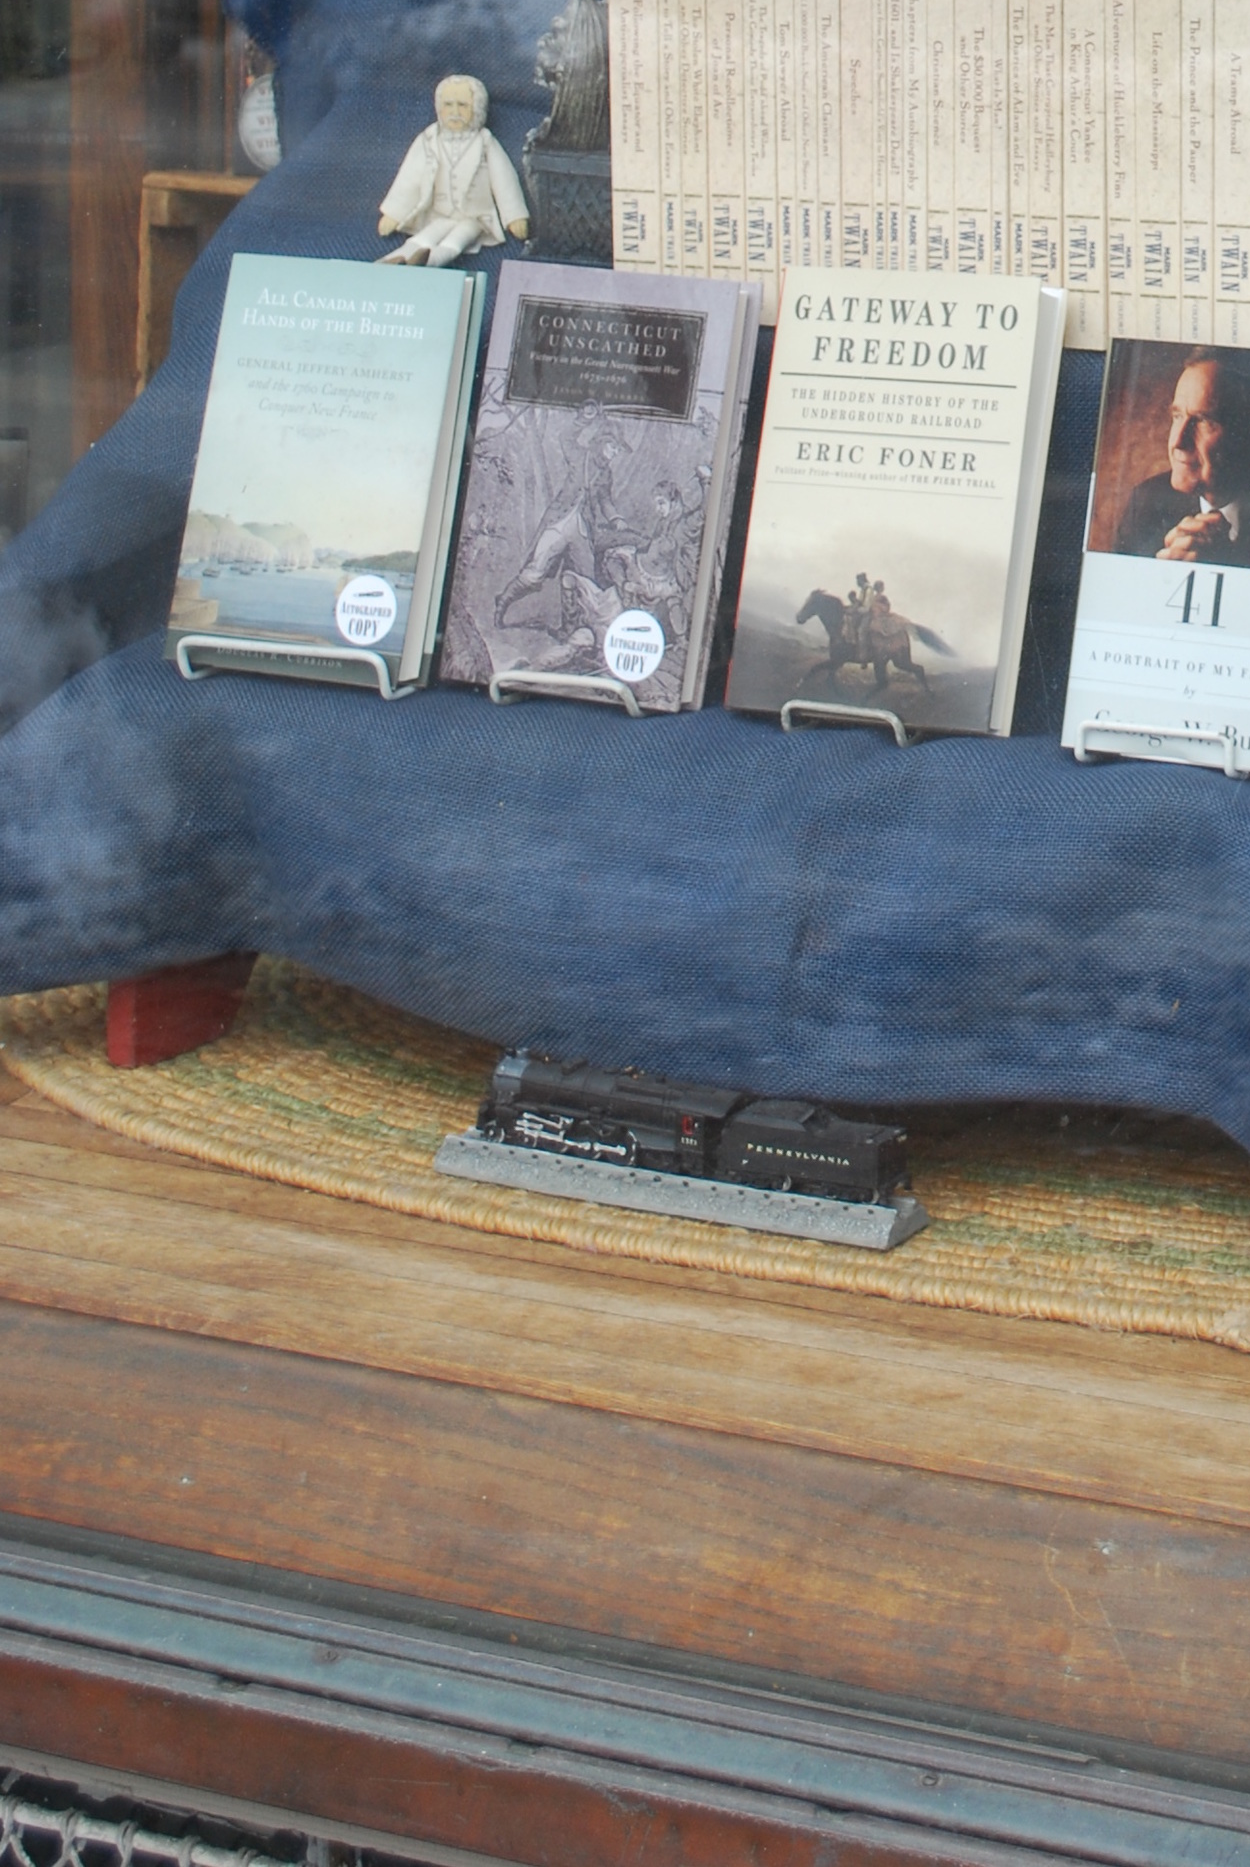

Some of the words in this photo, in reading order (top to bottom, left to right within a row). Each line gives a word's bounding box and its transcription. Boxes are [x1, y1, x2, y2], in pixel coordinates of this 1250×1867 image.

[848, 58, 861, 117] Speeches
[293, 289, 356, 313] CANADA
[361, 300, 378, 314] IN
[384, 301, 416, 317] THE
[794, 292, 958, 330] GATEWAY
[976, 303, 1020, 332] TO
[241, 306, 296, 329] HANDS
[300, 317, 320, 331] OF
[324, 319, 355, 334] THE
[359, 316, 425, 340] BRITISH
[538, 314, 682, 341] CONNECTICUT
[549, 333, 667, 358] UNSCATHED
[811, 334, 990, 371] FREEDOM
[791, 387, 816, 402] THE
[822, 389, 875, 406] HIDDEN
[881, 392, 942, 409] HISTORY
[947, 396, 965, 410] OF
[971, 397, 999, 412] THE
[801, 407, 903, 425] UNDERGROUND
[910, 412, 982, 429] RAILROAD
[796, 441, 866, 466] ERIC
[879, 447, 978, 472] FONER
[339, 600, 393, 618] AUTOGRAPHED
[1165, 569, 1226, 629] 41
[348, 616, 380, 639] COPY
[609, 633, 660, 656] AUTOGRAPHED
[615, 651, 647, 674] COPY
[1089, 650, 1099, 663] A
[1103, 650, 1181, 672] PORTRAIT
[1186, 659, 1206, 674] OF
[1213, 662, 1233, 677] MY
[1182, 684, 1197, 700] by
[746, 1142, 851, 1166] PENNSYLVANIA
